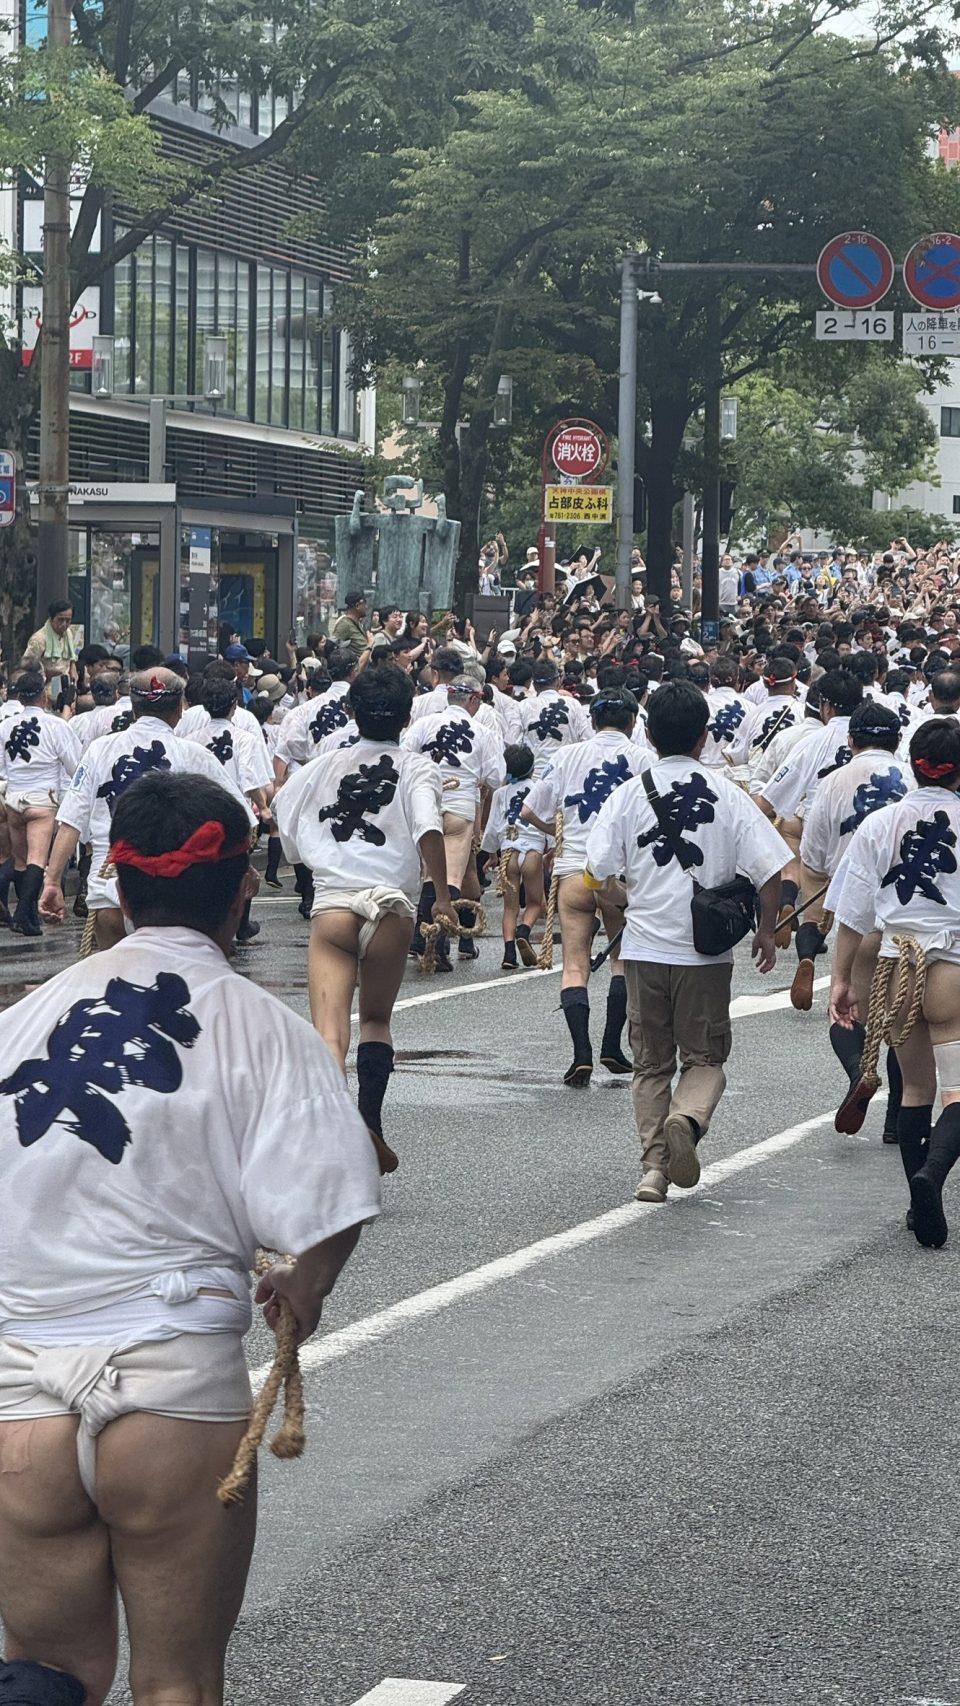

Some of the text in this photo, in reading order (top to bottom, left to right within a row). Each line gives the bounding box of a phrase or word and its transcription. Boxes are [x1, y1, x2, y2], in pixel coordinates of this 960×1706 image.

[844, 235, 868, 244] 2-16
[557, 442, 596, 462] 消火栓
[549, 496, 609, 511] 占部皮ふ科
